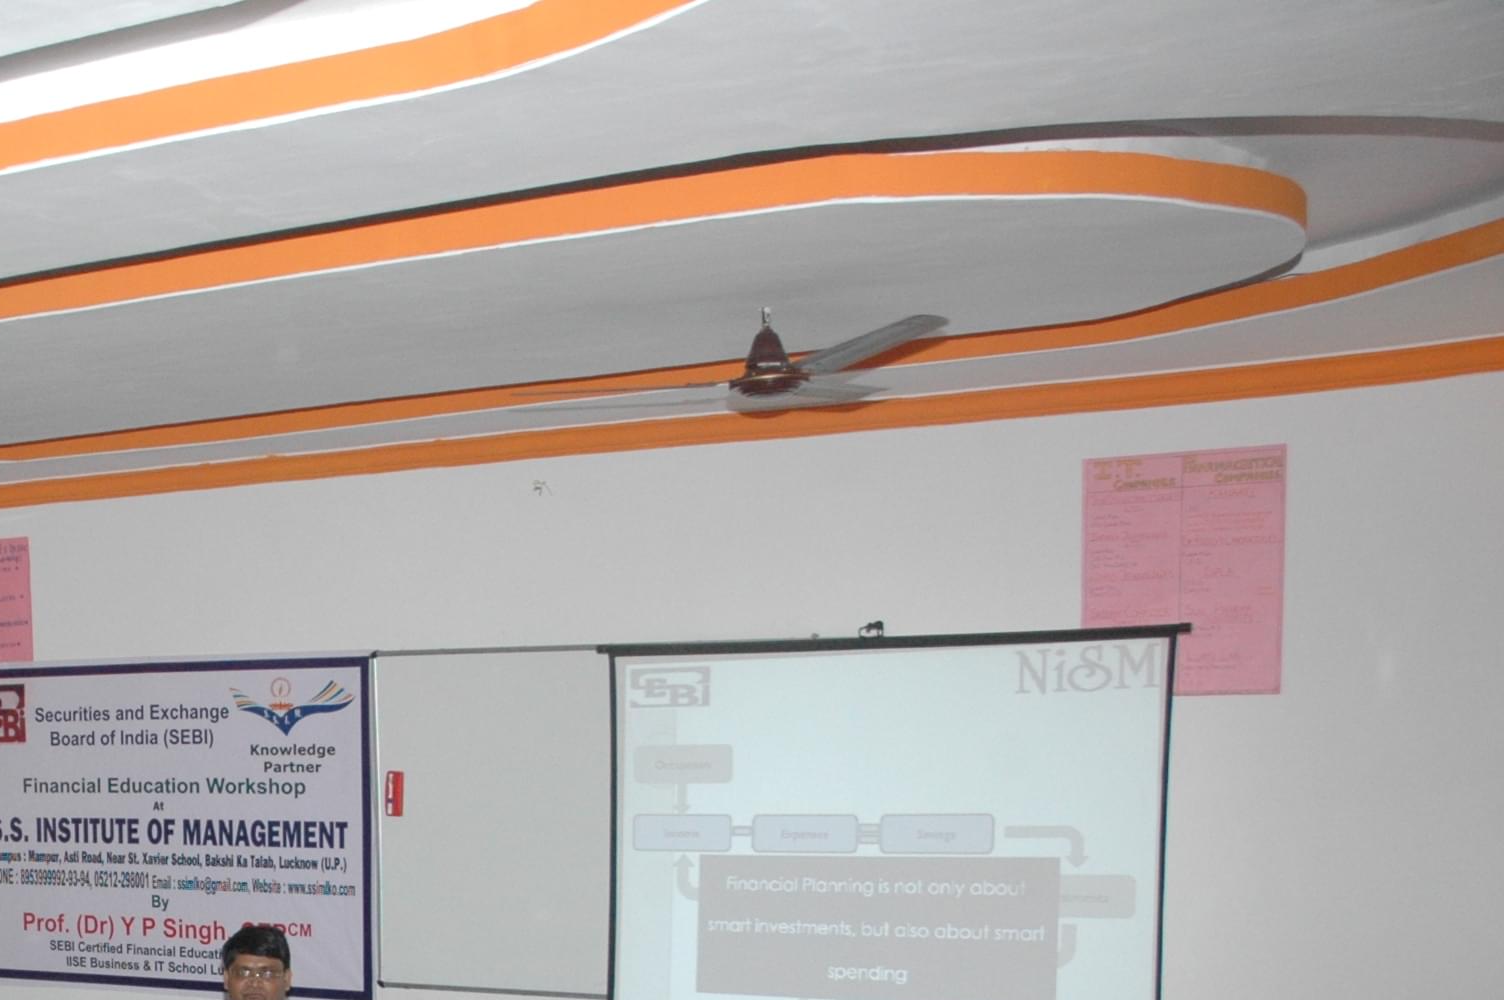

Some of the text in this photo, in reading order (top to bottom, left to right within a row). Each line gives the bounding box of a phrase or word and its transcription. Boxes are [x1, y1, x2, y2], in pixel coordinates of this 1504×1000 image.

[35, 703, 229, 723] Securities and Exchange
[50, 728, 214, 748] Board of India (SEBI)
[250, 744, 336, 758] Knowledge
[264, 761, 322, 773] Partner
[23, 777, 306, 799] Financial Education Workshop
[153, 801, 164, 811] At
[36, 817, 140, 844] INSTITUTE
[147, 818, 175, 845] OF
[183, 818, 348, 849] MANAGEMENT
[82, 851, 104, 865] Road,
[107, 851, 125, 864] Near
[128, 852, 139, 864] St.
[142, 853, 169, 865] Xavier
[171, 853, 202, 868] School,
[205, 854, 234, 867] Bakshi
[279, 855, 318, 870] Lucknow
[321, 856, 347, 873] (U.P.)
[726, 875, 1025, 898] Financial Planning is not only about
[151, 894, 170, 911] By
[23, 912, 70, 933] Prof.
[77, 914, 115, 940] (Dr)
[121, 915, 135, 936] Y
[142, 917, 156, 937] P
[707, 917, 1046, 941] smart investments, but also about smart
[49, 939, 75, 951] SEBI
[78, 941, 123, 954] Certified
[126, 943, 176, 957] Financial
[66, 955, 87, 968] IISE
[90, 957, 140, 971] Business
[143, 960, 151, 972] &
[155, 960, 165, 973] IT
[168, 961, 207, 975] School
[827, 964, 908, 984] spending
